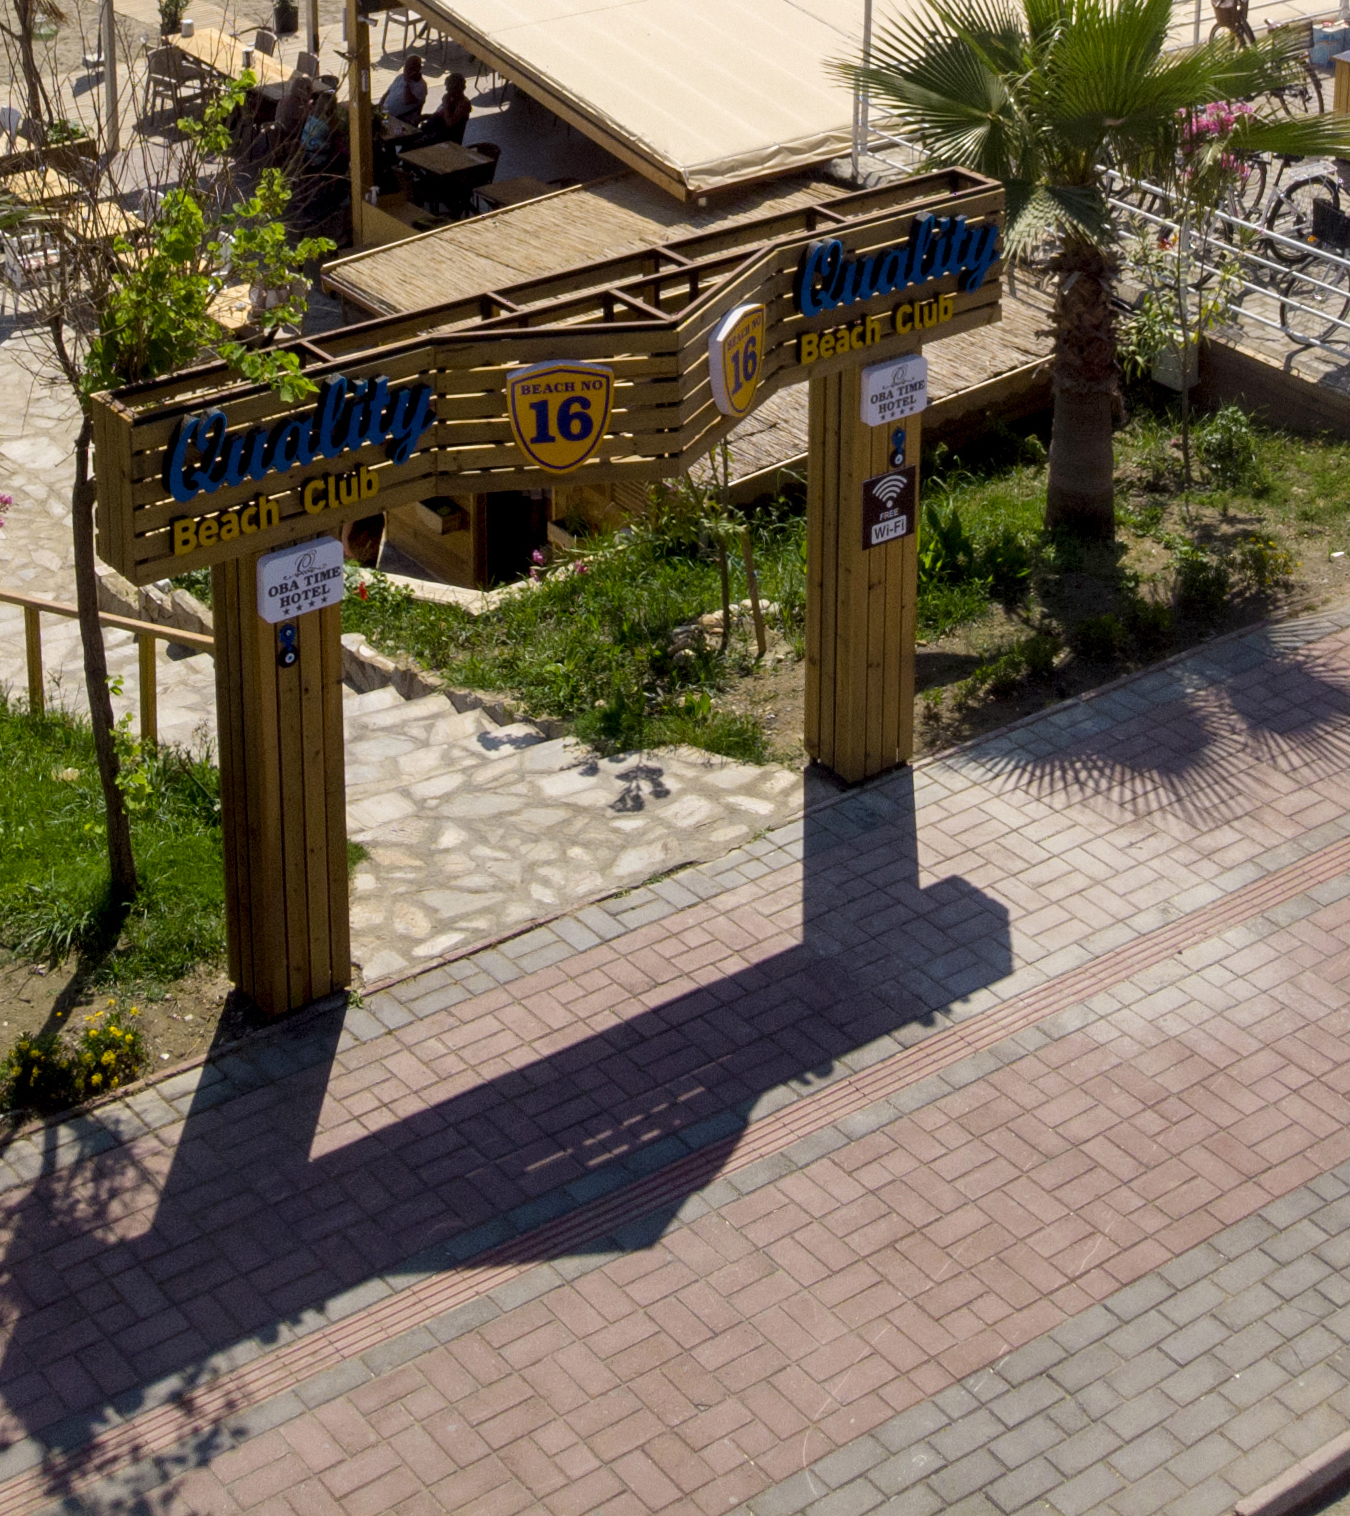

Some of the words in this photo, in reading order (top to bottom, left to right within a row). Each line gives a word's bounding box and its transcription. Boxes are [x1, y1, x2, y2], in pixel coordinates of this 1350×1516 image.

[800, 212, 1001, 317] Quality
[800, 315, 881, 364] Beach
[895, 294, 954, 334] Club
[731, 335, 757, 396] 16
[520, 382, 575, 396] BEACH
[581, 379, 603, 391] NO
[870, 391, 894, 405] OBA
[897, 379, 925, 396] TIME
[529, 395, 594, 444] 16
[878, 395, 917, 414] HOTEL
[168, 375, 437, 502] Quality
[173, 496, 280, 556] Beach
[304, 466, 379, 515] Club
[879, 507, 899, 521] FREE
[874, 518, 905, 540] Wi-Fi
[268, 580, 300, 598] OBA
[304, 566, 341, 587] TIME
[279, 584, 331, 608] HOTEL
